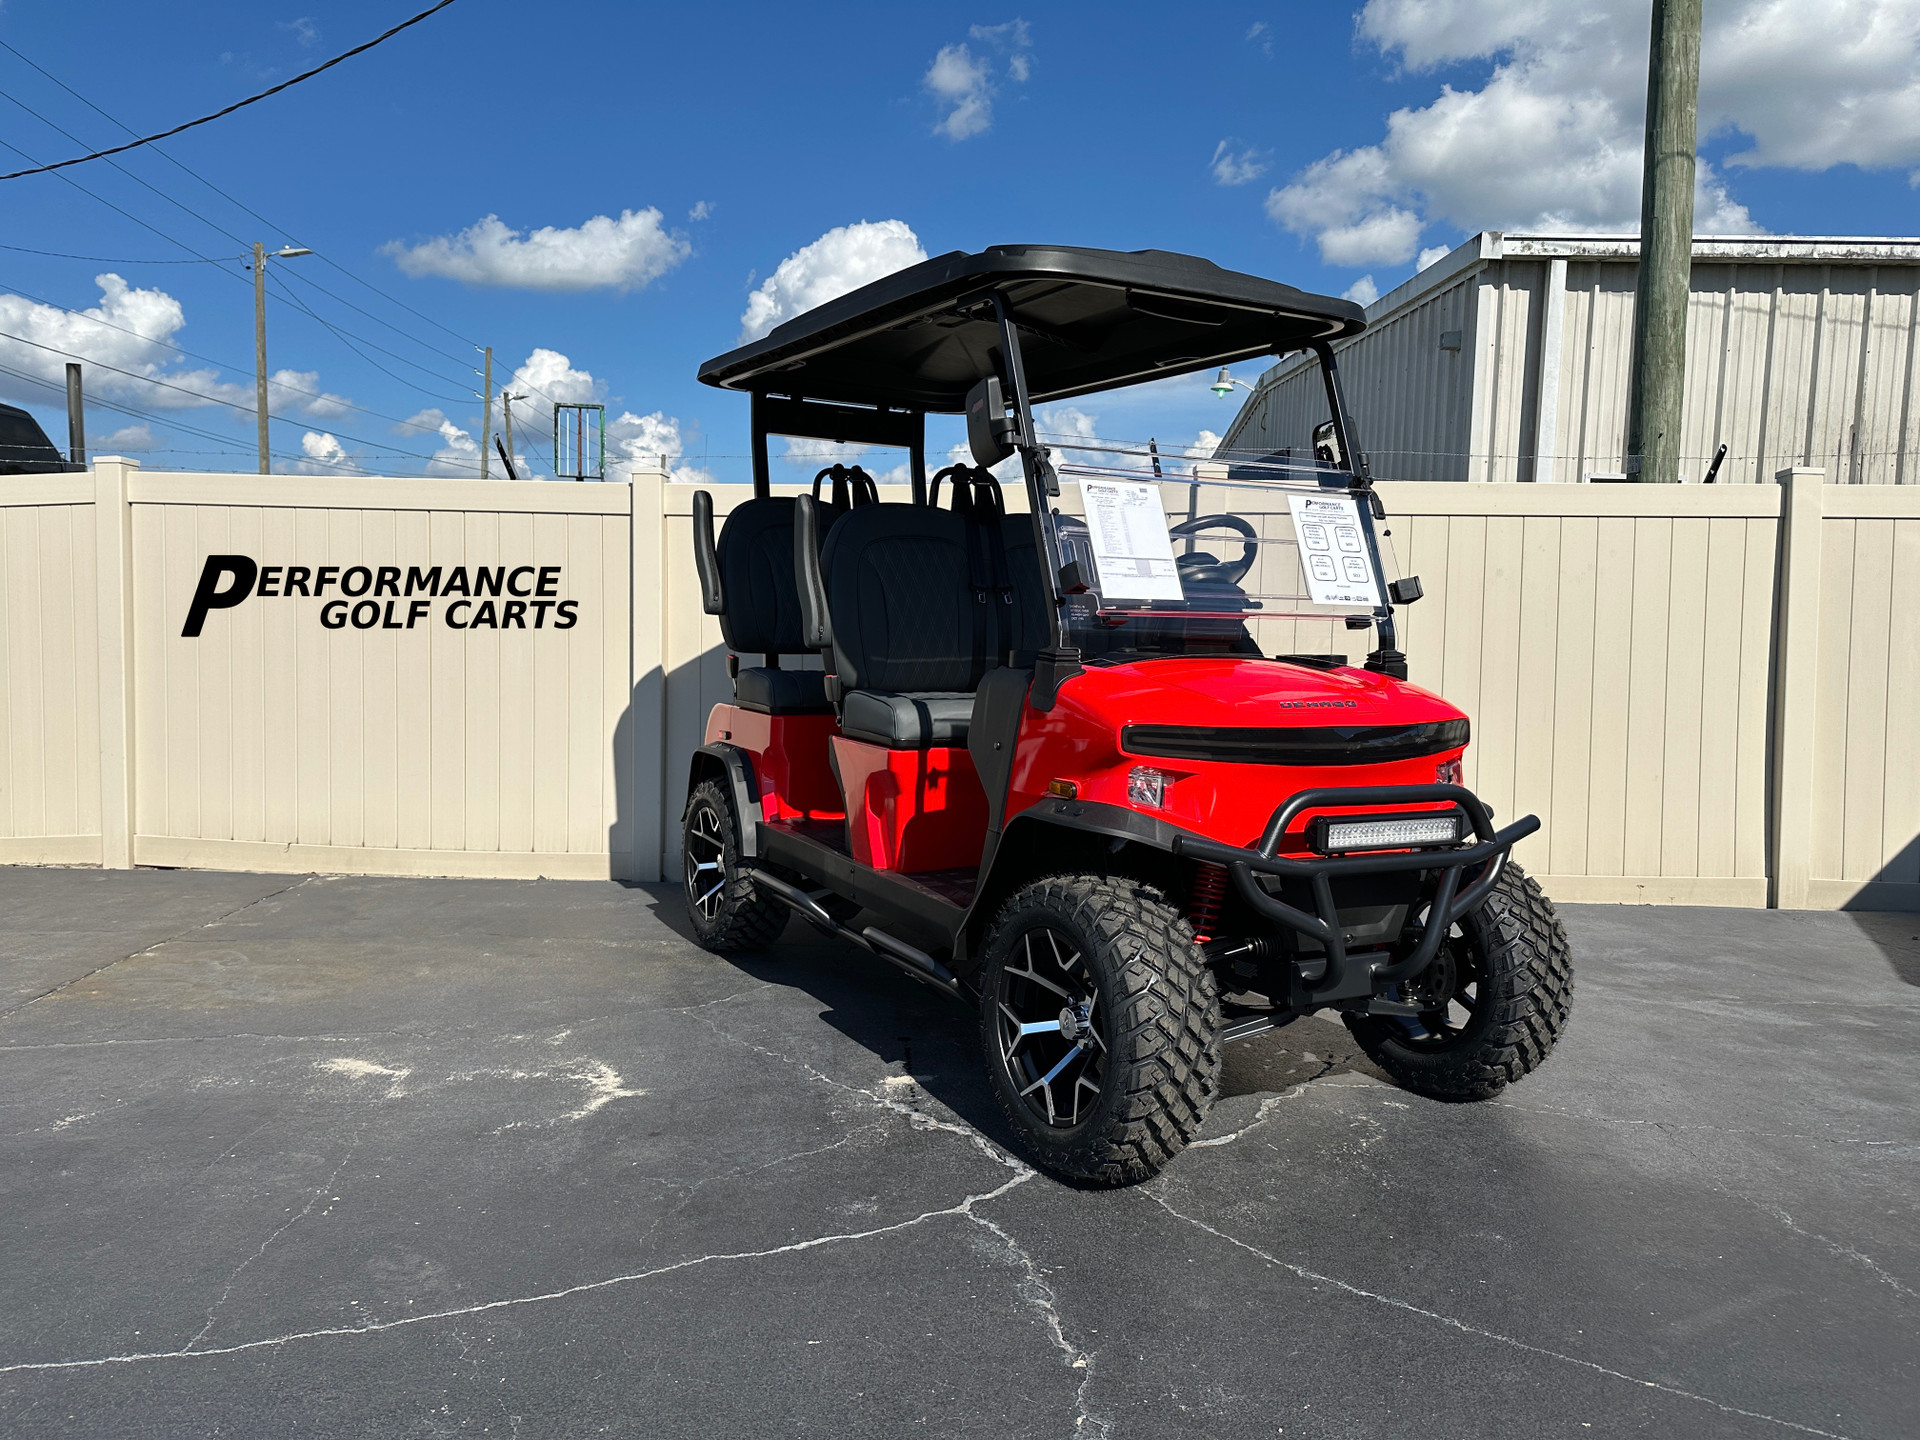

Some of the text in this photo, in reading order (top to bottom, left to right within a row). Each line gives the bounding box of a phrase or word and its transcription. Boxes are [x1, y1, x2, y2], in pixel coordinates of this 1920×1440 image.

[181, 555, 561, 637] PERFORMANCE
[320, 600, 578, 629] GOLF CARTS
